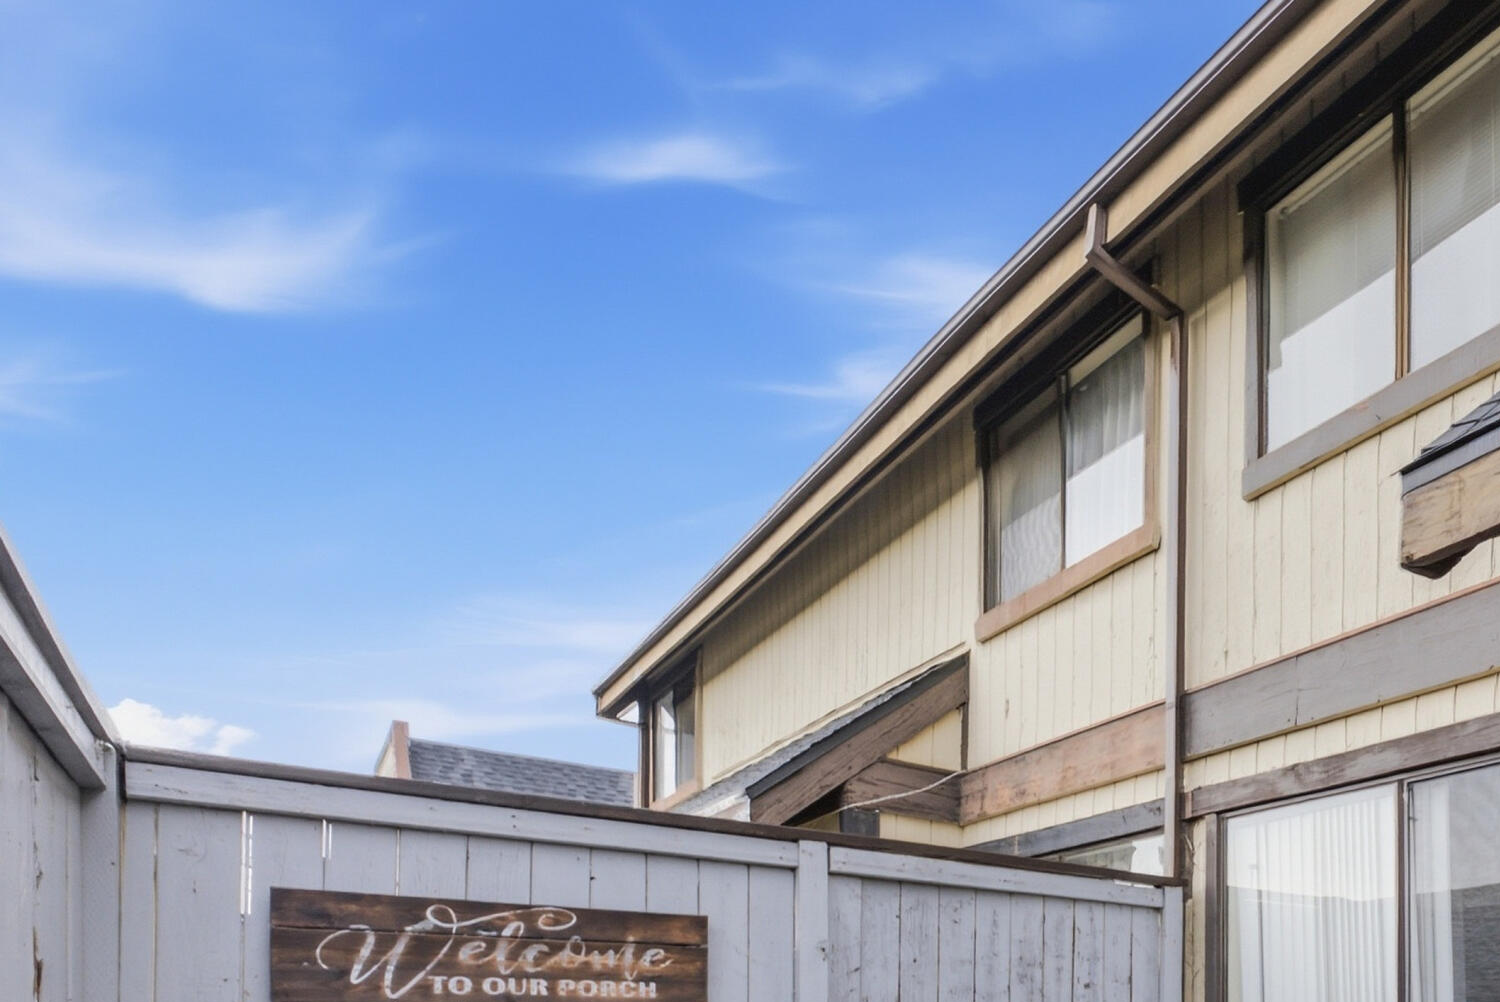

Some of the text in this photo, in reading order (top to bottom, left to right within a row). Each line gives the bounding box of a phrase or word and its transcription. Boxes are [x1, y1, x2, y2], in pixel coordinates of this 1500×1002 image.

[316, 904, 673, 999] Welcome
[428, 975, 657, 998] TO OUR PORCH
